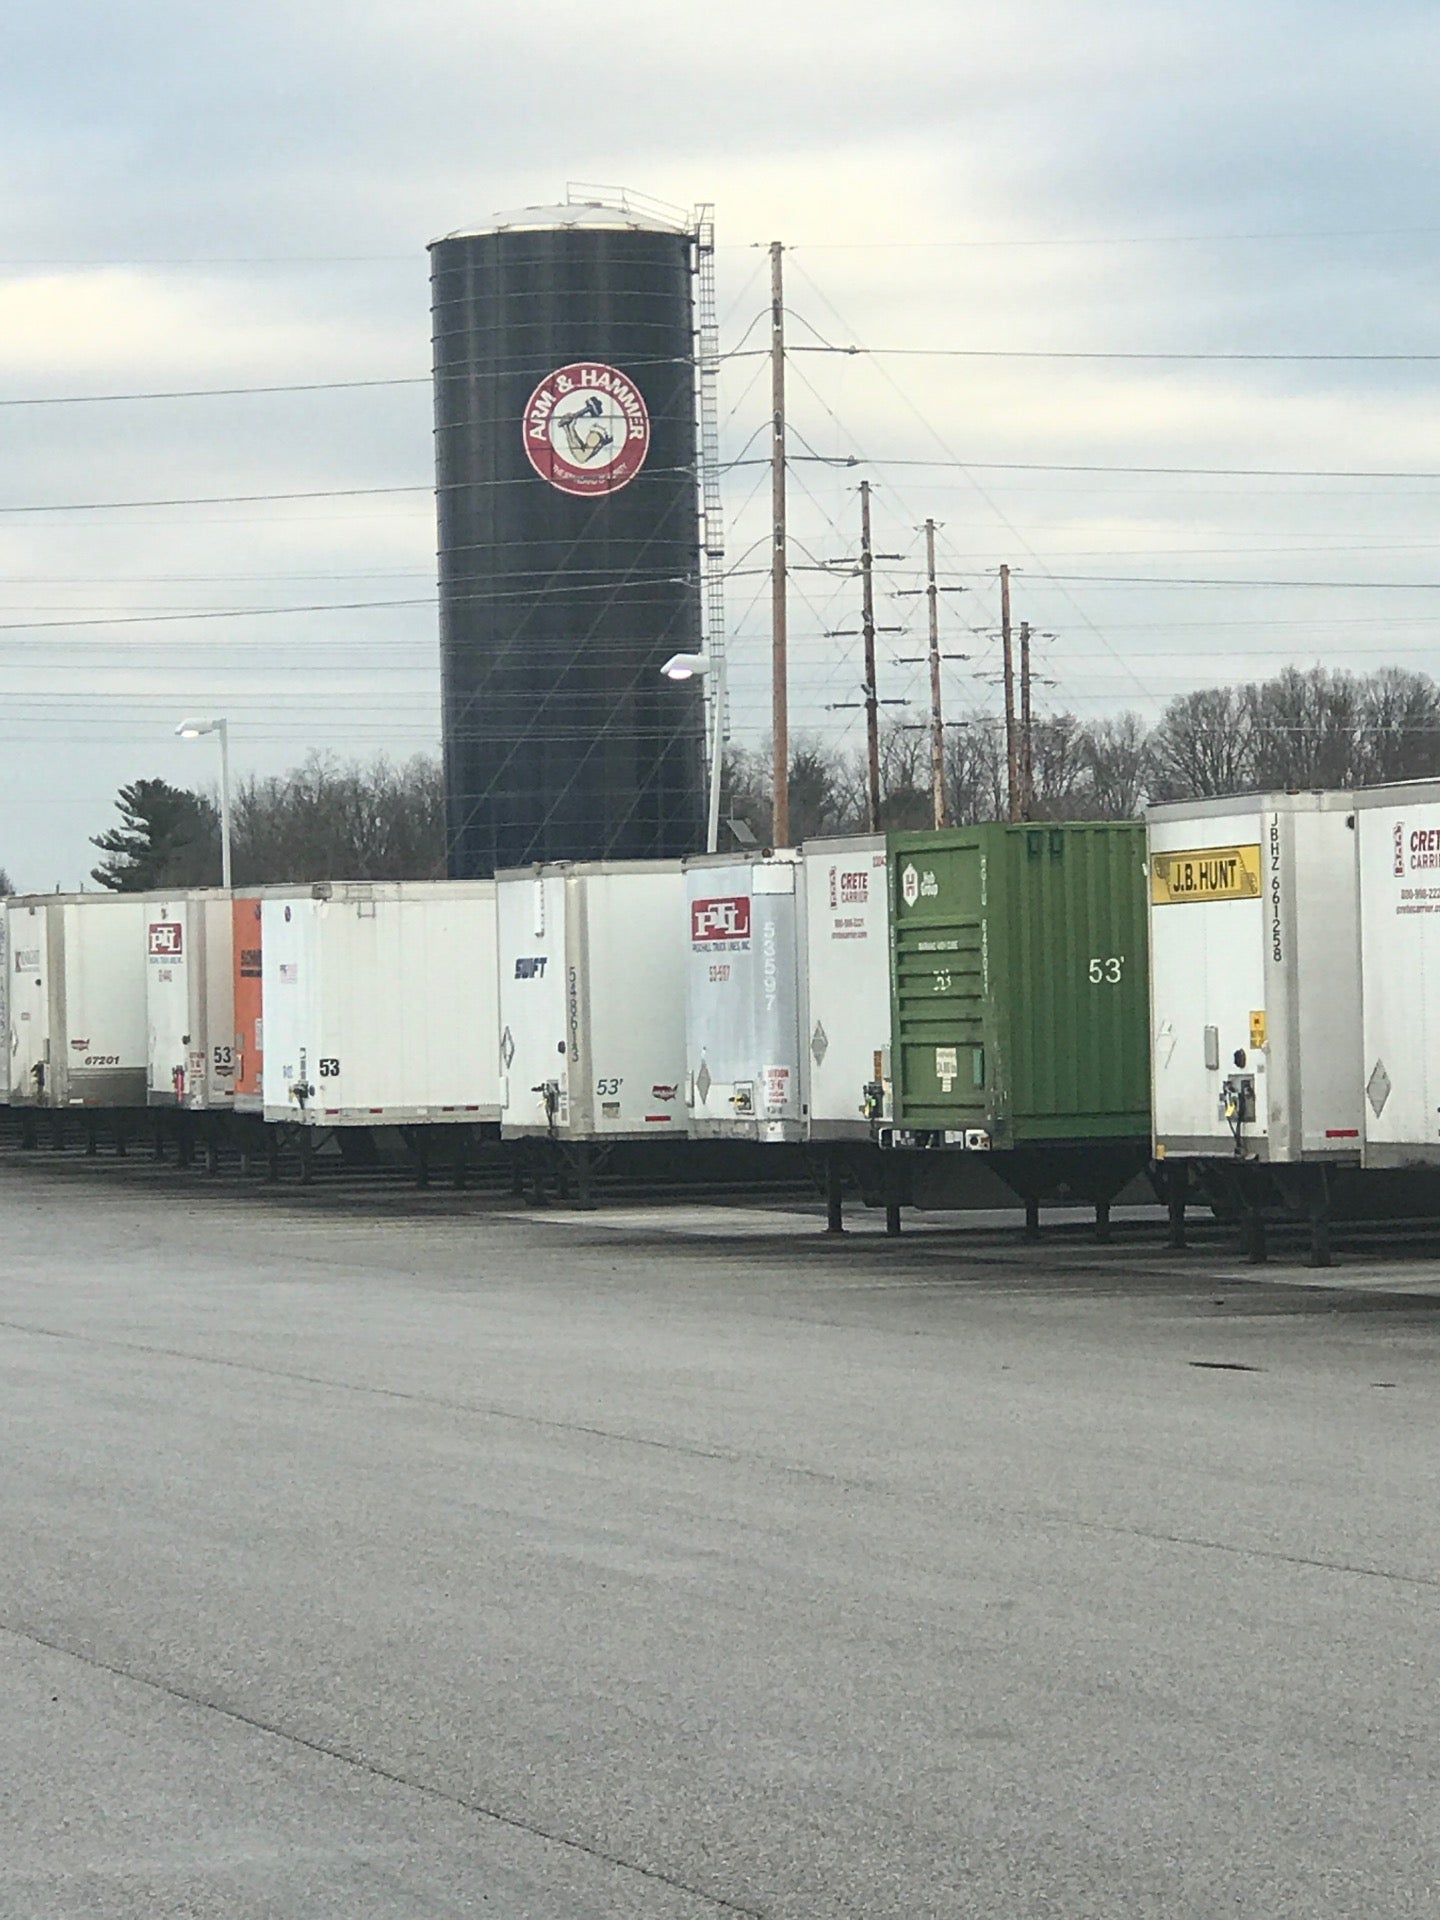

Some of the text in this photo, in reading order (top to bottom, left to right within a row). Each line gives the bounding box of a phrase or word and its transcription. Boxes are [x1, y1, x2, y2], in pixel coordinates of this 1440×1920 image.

[529, 369, 645, 441] ARM & HAMMER
[1410, 853, 1440, 869] CARRI
[841, 872, 868, 889] CRETE
[1173, 859, 1236, 892] J.B. HUNT
[1269, 812, 1282, 962] JBHZ 661258
[694, 902, 748, 936] PTL
[1089, 956, 1125, 983] 53'
[85, 1056, 120, 1066] 67201
[319, 1058, 340, 1077] 53
[596, 1078, 623, 1096] 53'
